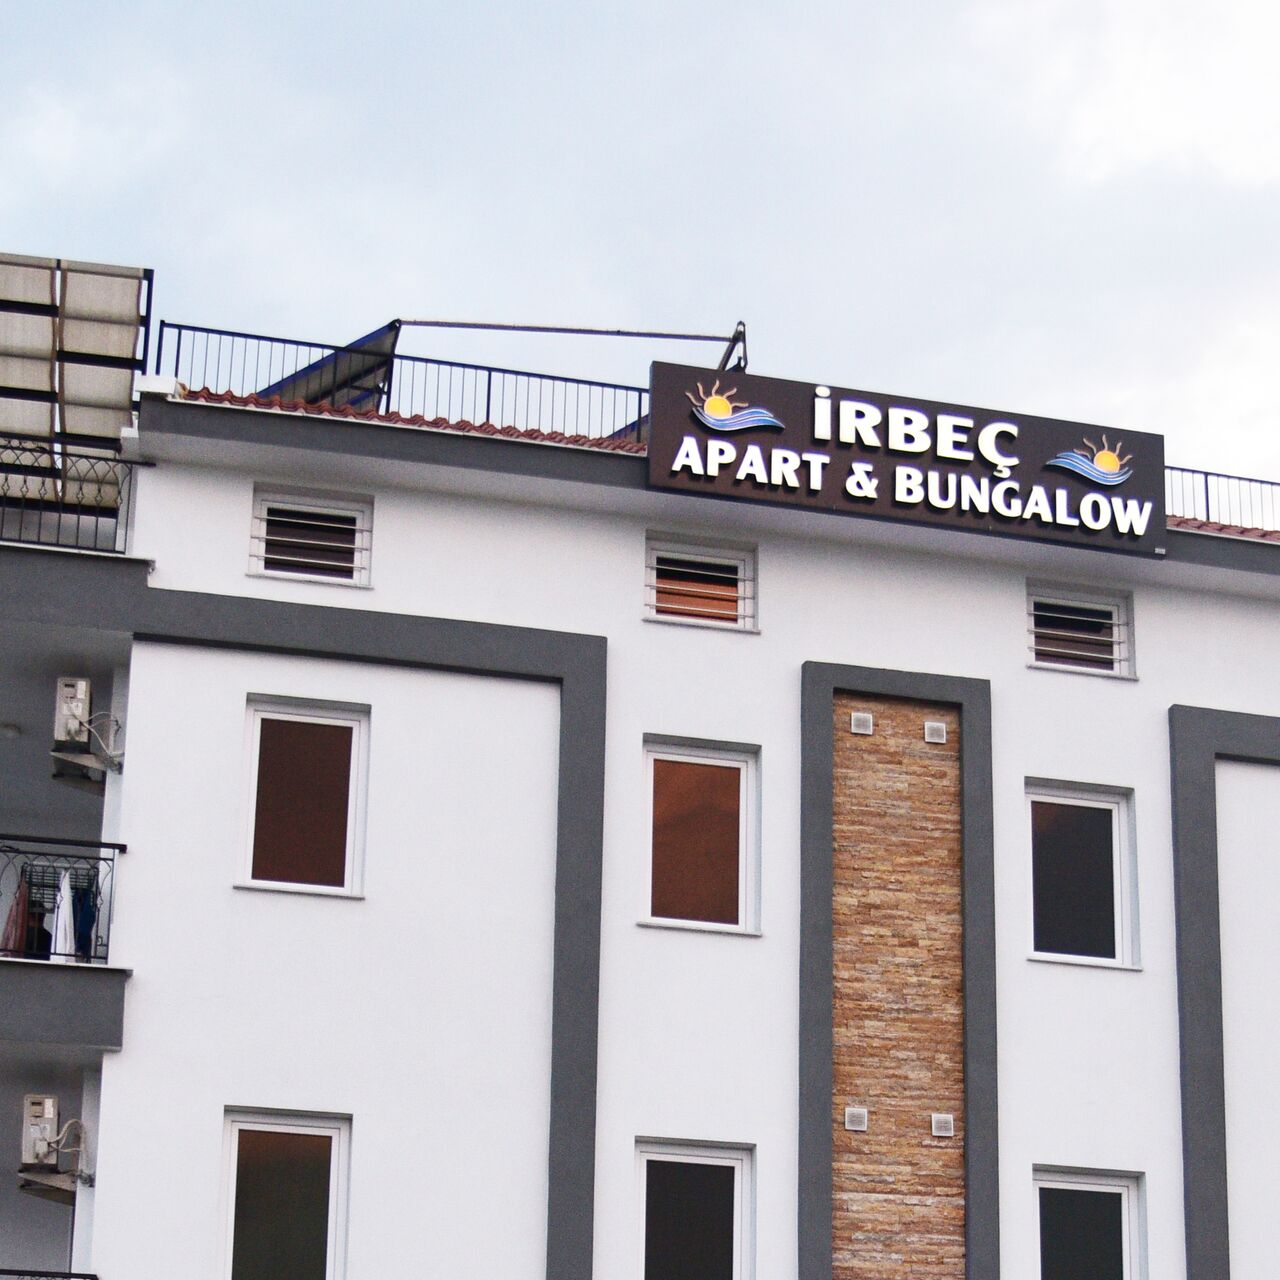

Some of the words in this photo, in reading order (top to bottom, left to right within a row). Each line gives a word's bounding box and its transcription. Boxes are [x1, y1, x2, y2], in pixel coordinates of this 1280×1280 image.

[814, 386, 1020, 479] İRBEÇ
[671, 436, 830, 491] APART
[845, 462, 879, 499] &
[894, 465, 1153, 536] BUNGALOW
